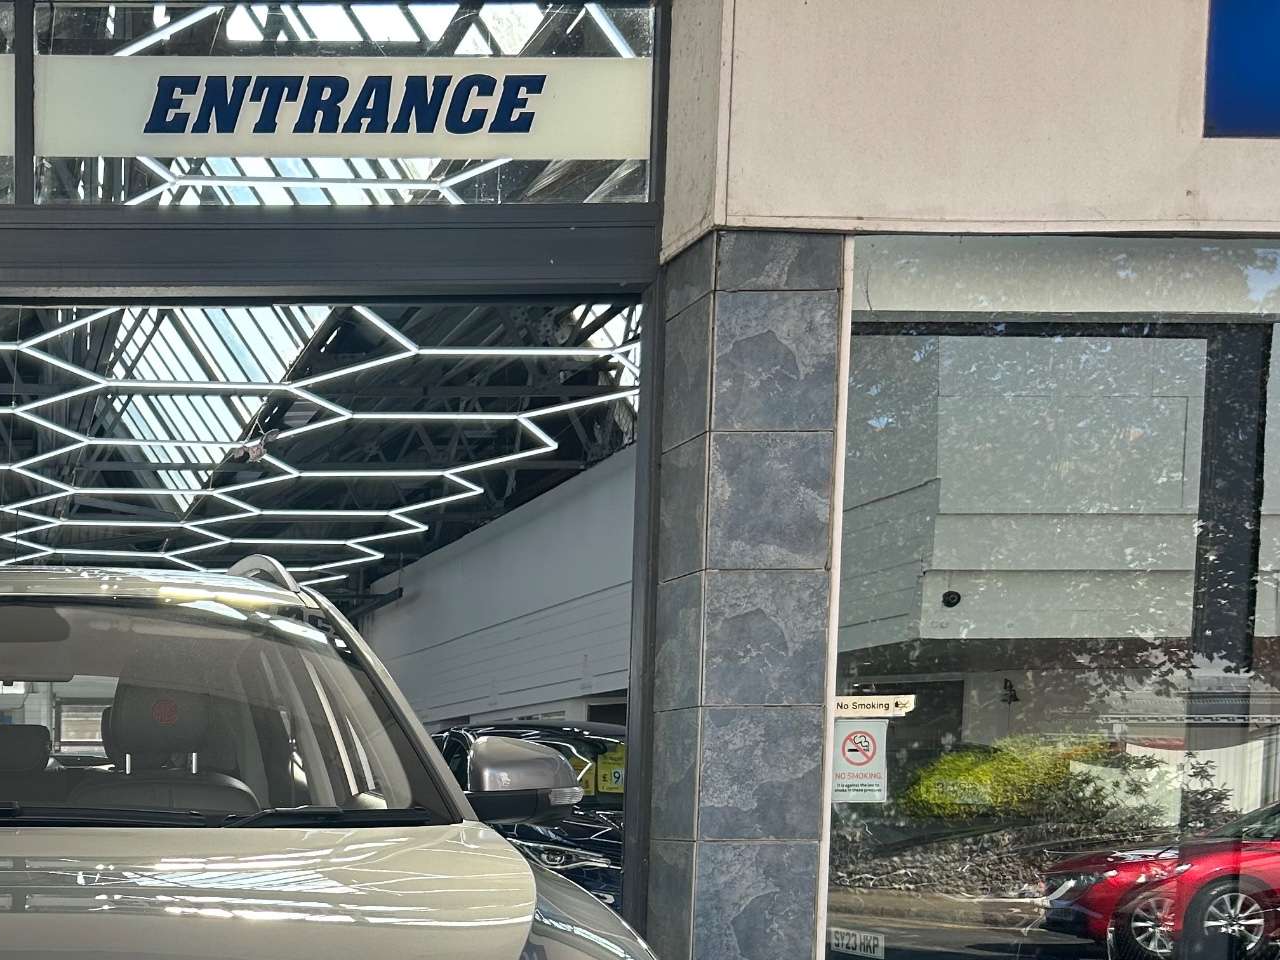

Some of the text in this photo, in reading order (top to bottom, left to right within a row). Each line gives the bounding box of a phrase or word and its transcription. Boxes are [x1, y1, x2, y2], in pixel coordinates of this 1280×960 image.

[143, 73, 547, 134] ENTRANCE
[836, 701, 890, 711] No Smoking
[835, 772, 881, 780] NO SMOKING
[833, 930, 879, 955] SY23 HKP
